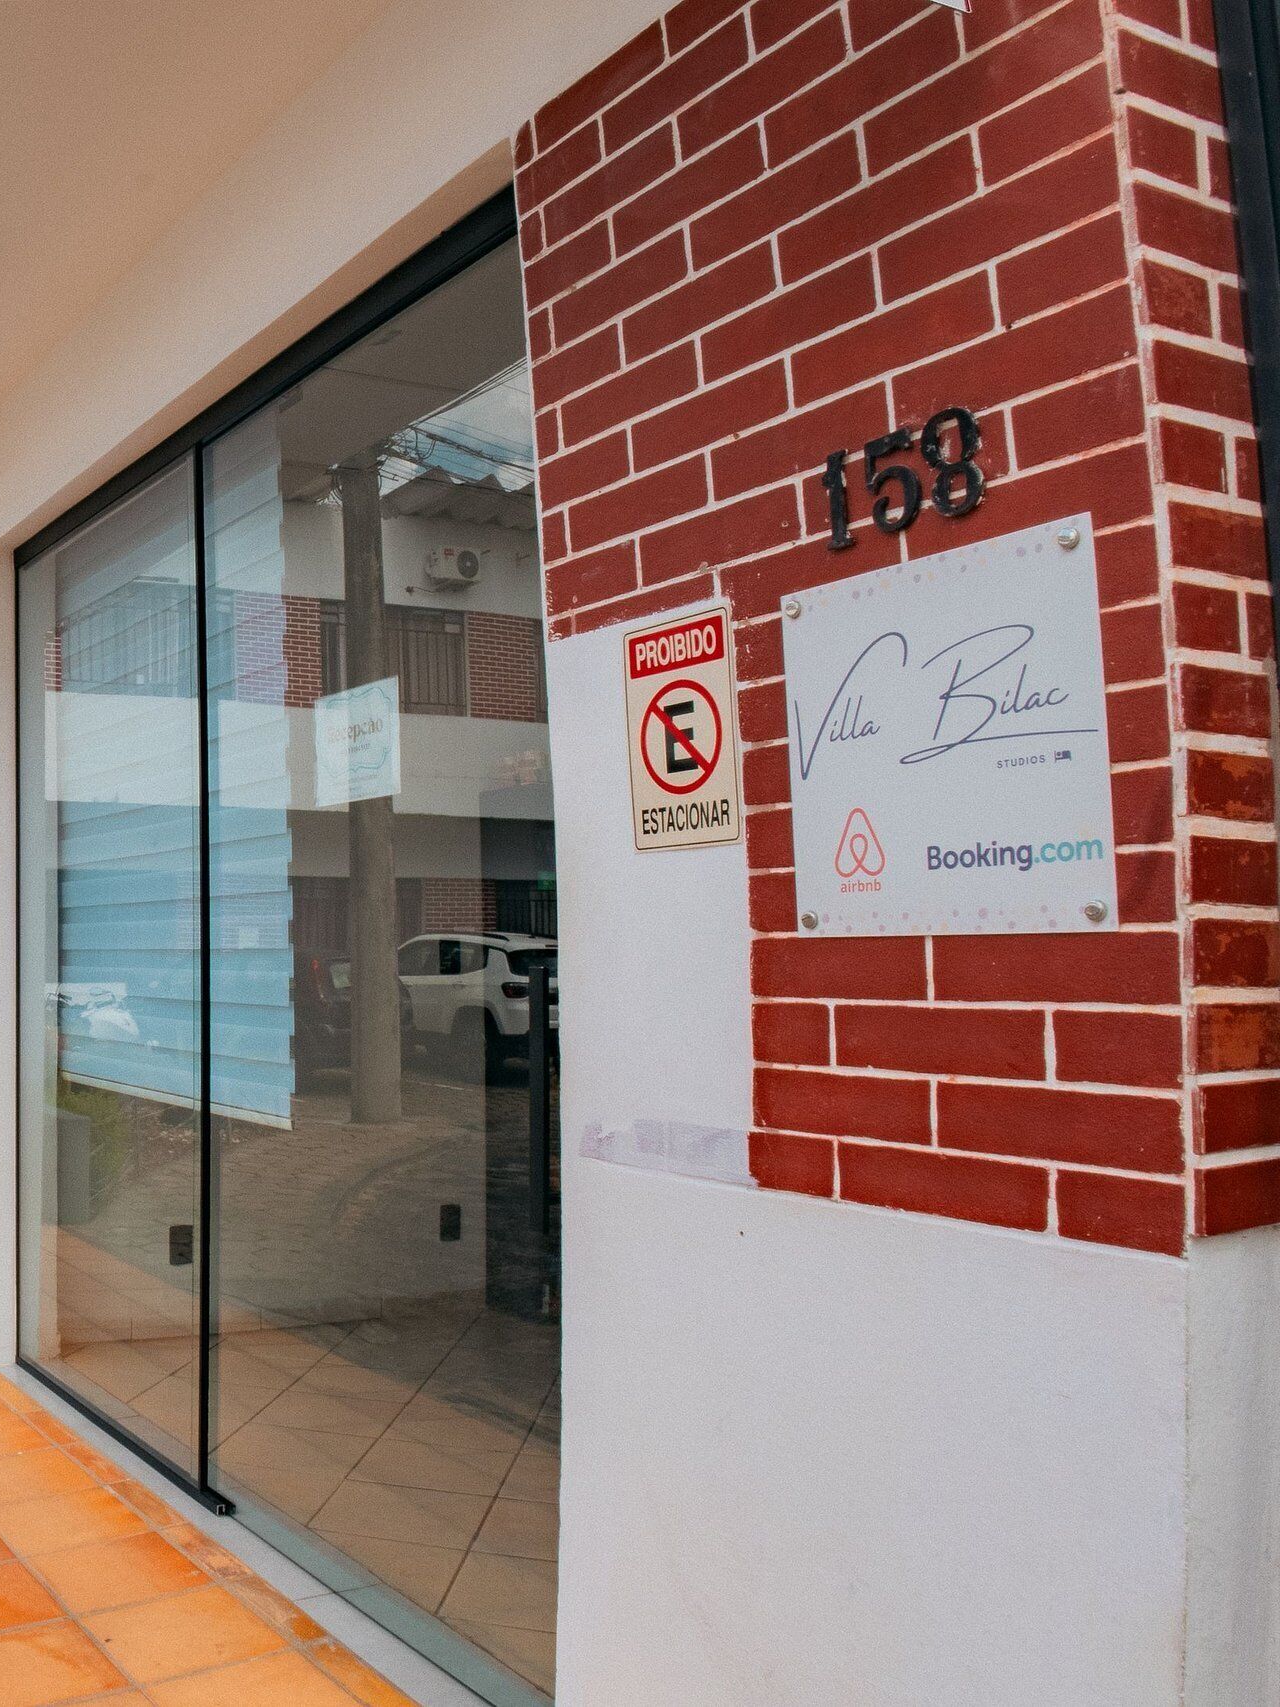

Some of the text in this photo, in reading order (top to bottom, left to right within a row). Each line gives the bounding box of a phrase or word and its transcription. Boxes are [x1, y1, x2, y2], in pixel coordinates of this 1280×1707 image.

[822, 407, 986, 550] 158
[635, 624, 717, 671] PROIBIDO
[795, 624, 1099, 780] Villa Bilac
[664, 700, 699, 774] E
[996, 755, 1046, 769] STUDIOS
[642, 799, 730, 835] ESTACIONAR
[927, 838, 1104, 871] Booking.com
[840, 878, 881, 893] airbnb
